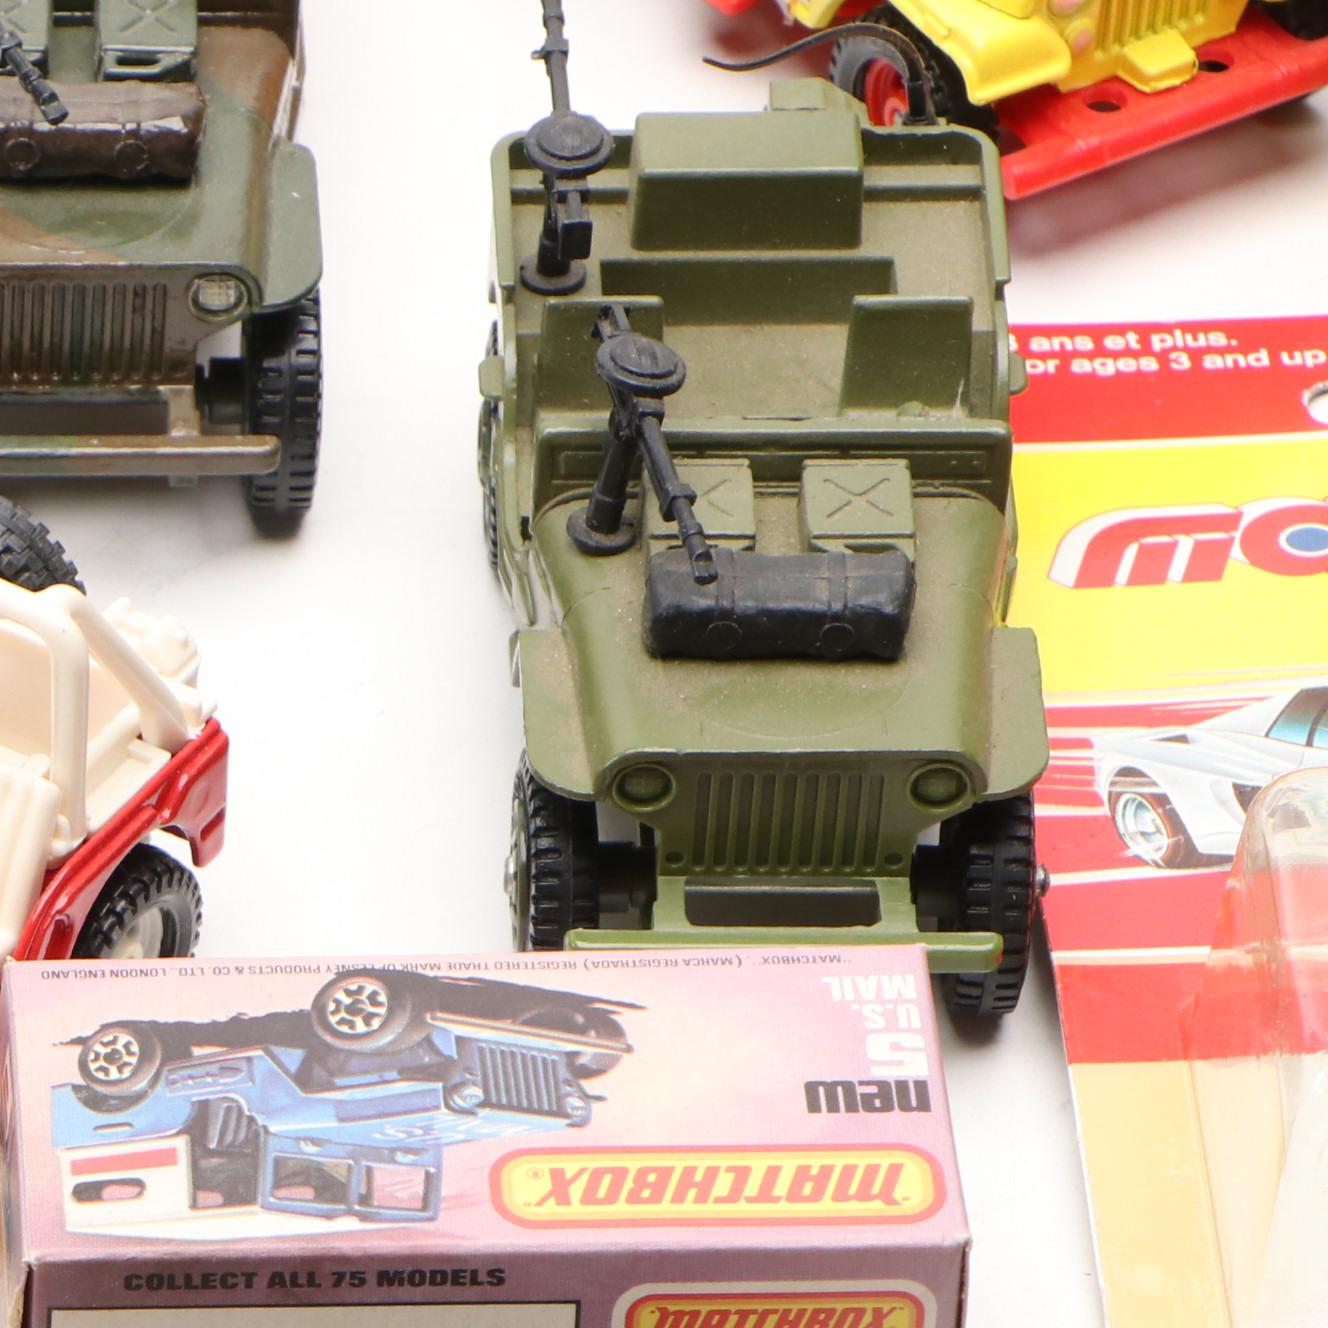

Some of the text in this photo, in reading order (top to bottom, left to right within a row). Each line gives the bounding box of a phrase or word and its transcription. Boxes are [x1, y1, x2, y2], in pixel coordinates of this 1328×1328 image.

[1029, 334, 1094, 351] ans
[1103, 331, 1141, 350] et
[1151, 329, 1238, 353] plus.
[1024, 358, 1060, 374] or
[1071, 355, 1160, 375] ages
[1169, 352, 1192, 370] 3
[1202, 348, 1270, 369] and
[41, 968, 107, 980] ENGLAND
[110, 967, 168, 979] LONDON
[248, 964, 322, 976] PRODUCTS
[821, 974, 918, 1001] MAIL
[851, 1003, 922, 1029] U.S.
[865, 1032, 930, 1076] 5
[804, 1079, 932, 1114] new
[123, 1267, 507, 1292] COLLECT ALL 75 MODELS
